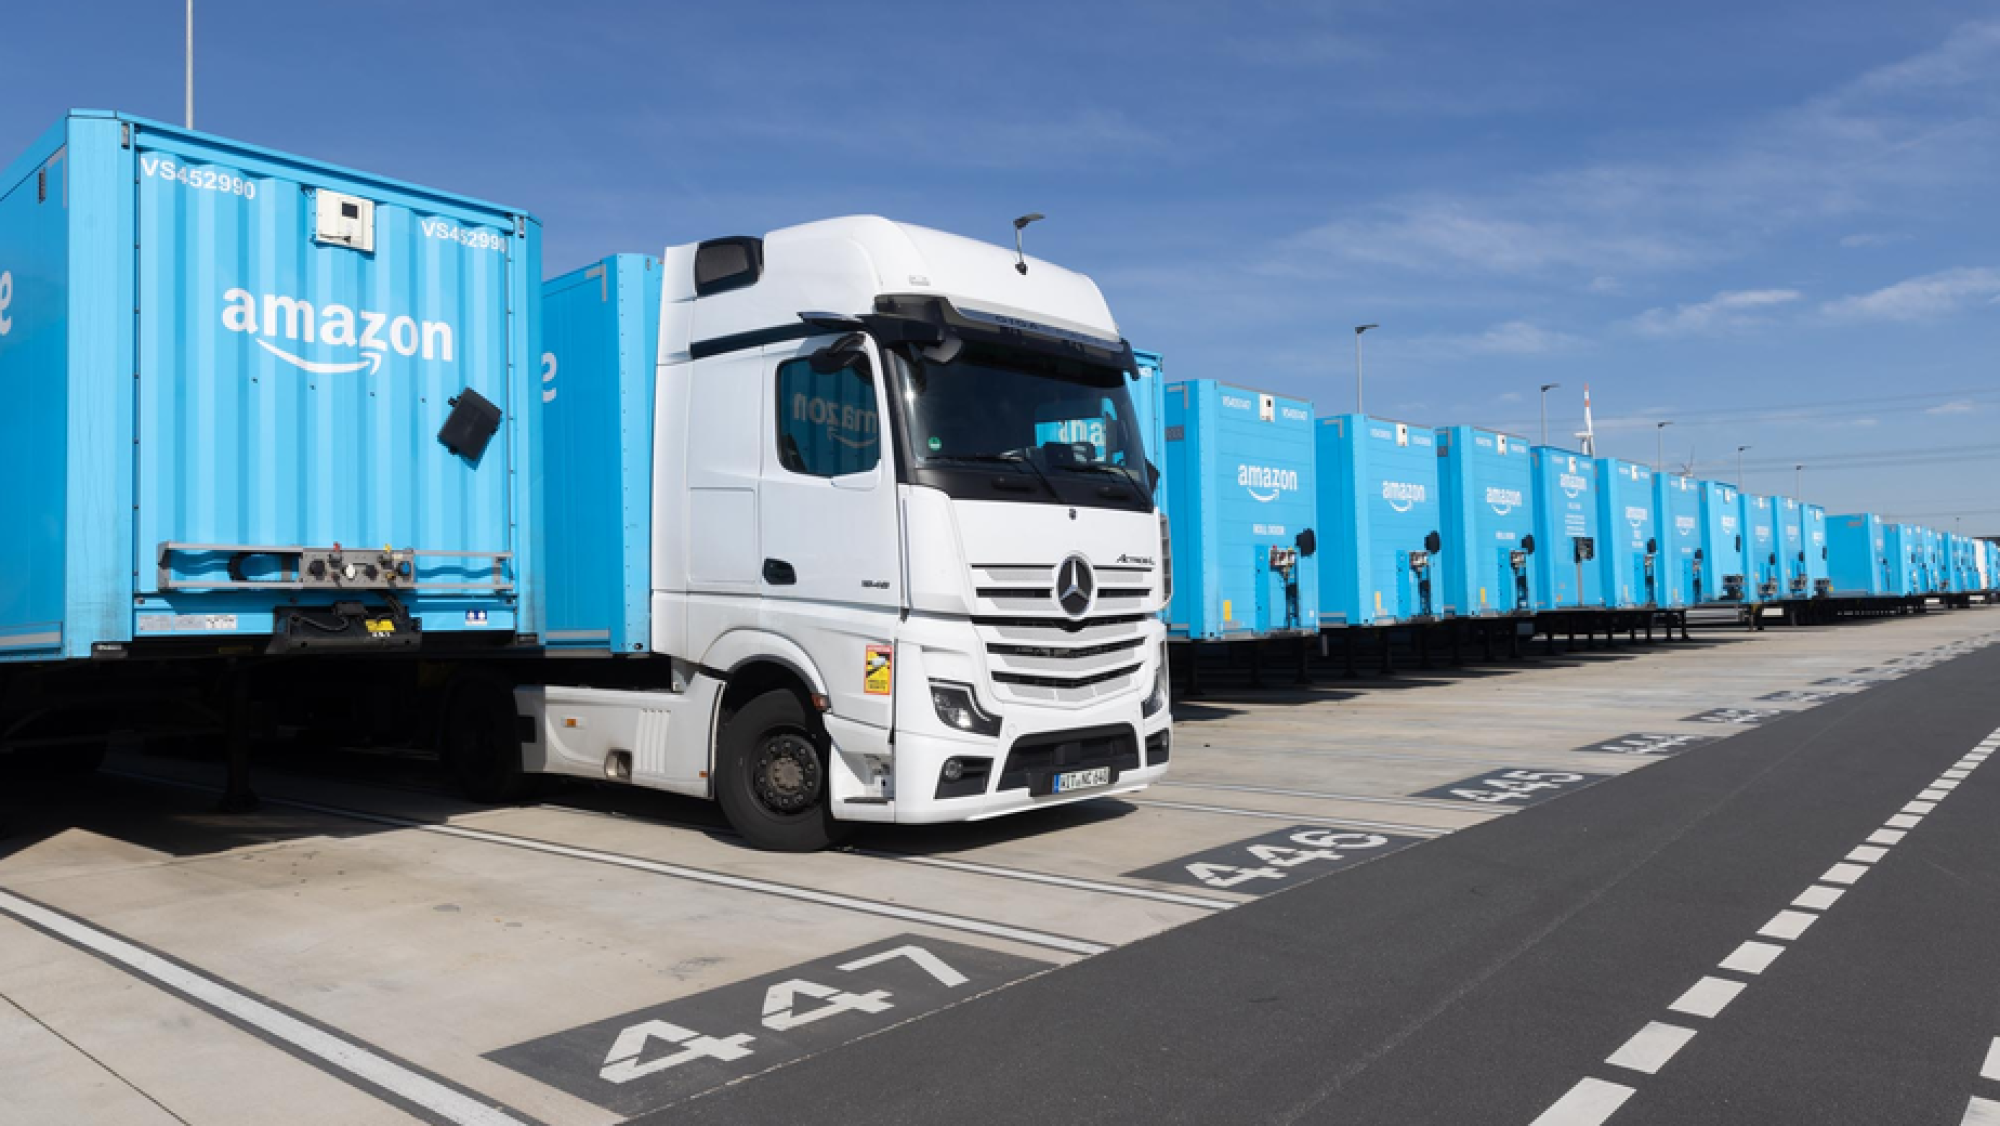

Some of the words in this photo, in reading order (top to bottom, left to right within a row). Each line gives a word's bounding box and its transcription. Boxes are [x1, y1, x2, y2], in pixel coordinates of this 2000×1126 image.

[140, 157, 256, 200] VS452990
[221, 287, 453, 362] amazon
[1237, 464, 1298, 491] amazon
[1450, 770, 1584, 802] 445
[1184, 828, 1389, 892] 446
[599, 944, 970, 1084] 447
